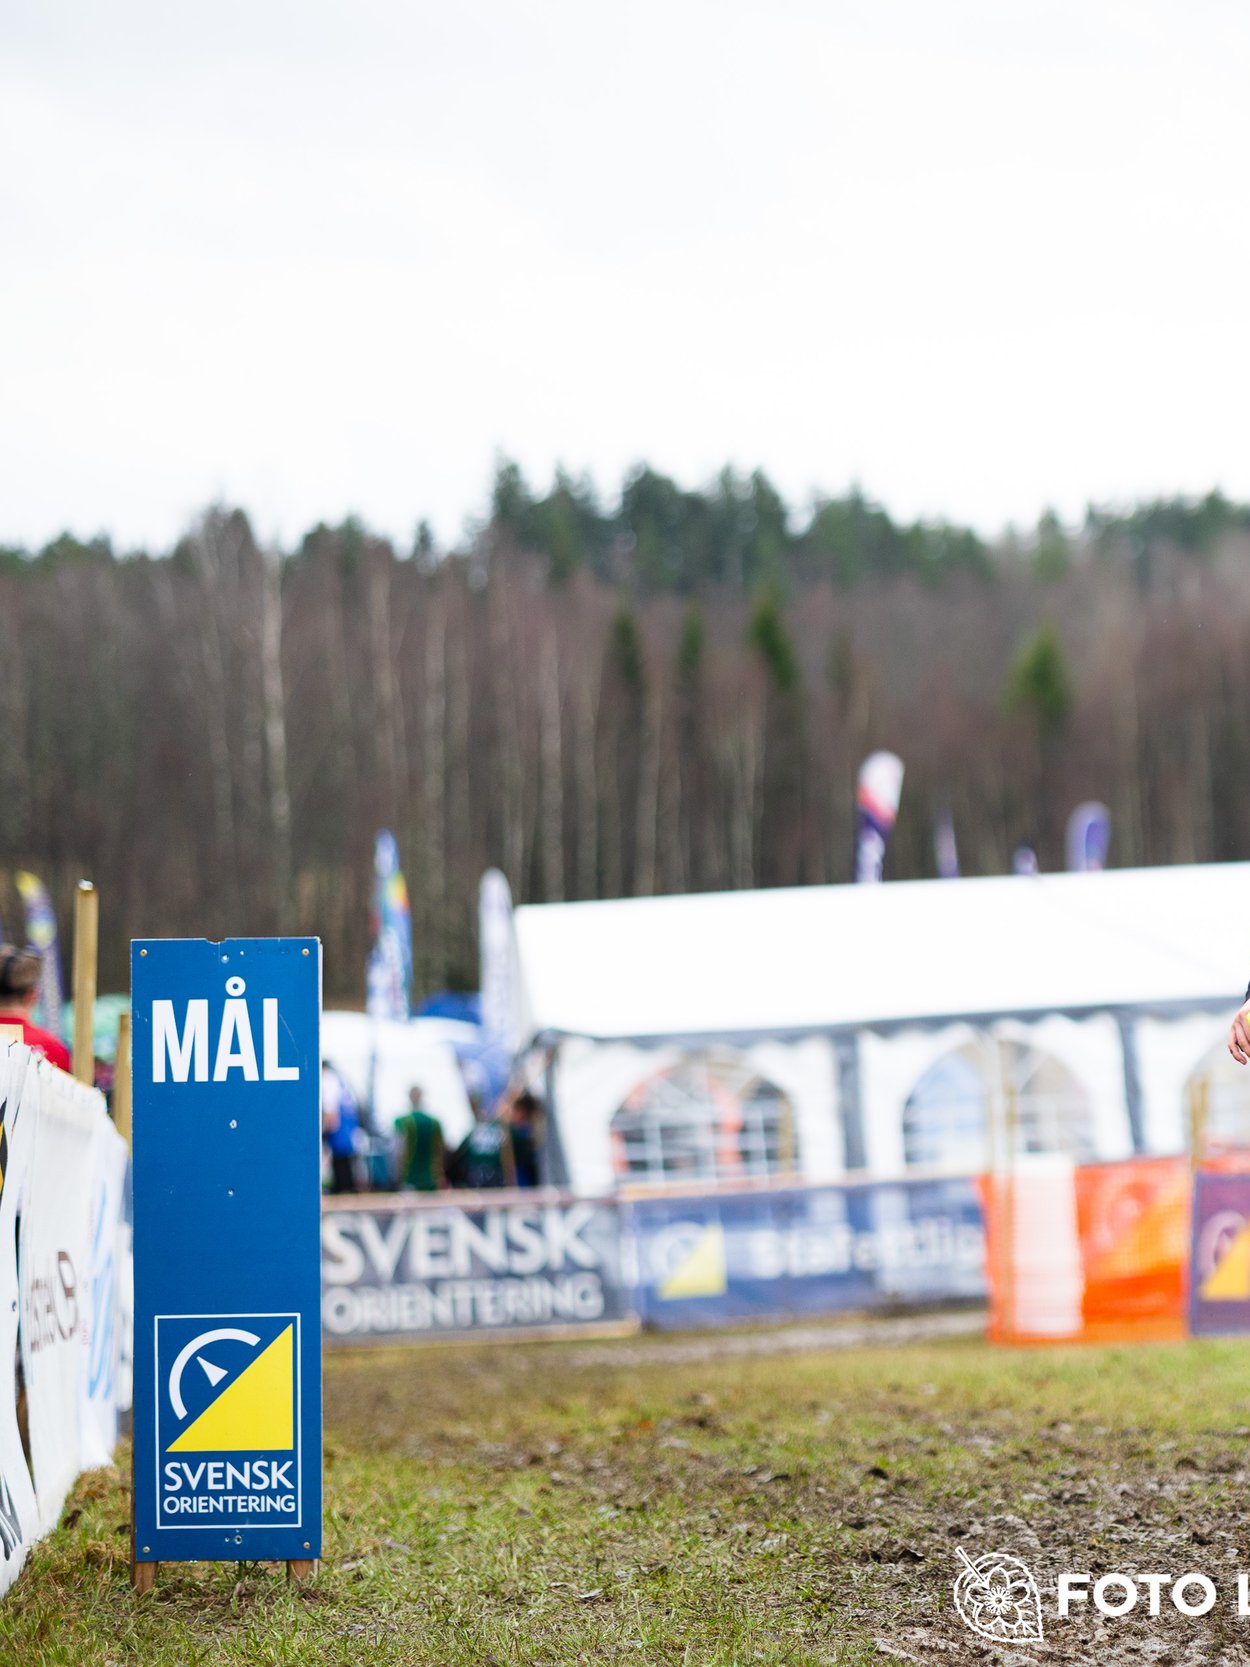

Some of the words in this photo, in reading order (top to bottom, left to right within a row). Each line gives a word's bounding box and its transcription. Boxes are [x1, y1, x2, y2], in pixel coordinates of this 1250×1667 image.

[152, 976, 300, 1083] MÅL
[322, 1203, 598, 1285] SVENSK
[322, 1272, 604, 1335] ORIENTERING
[163, 1495, 296, 1514] ORIENTERING
[164, 1461, 295, 1491] SVENSK
